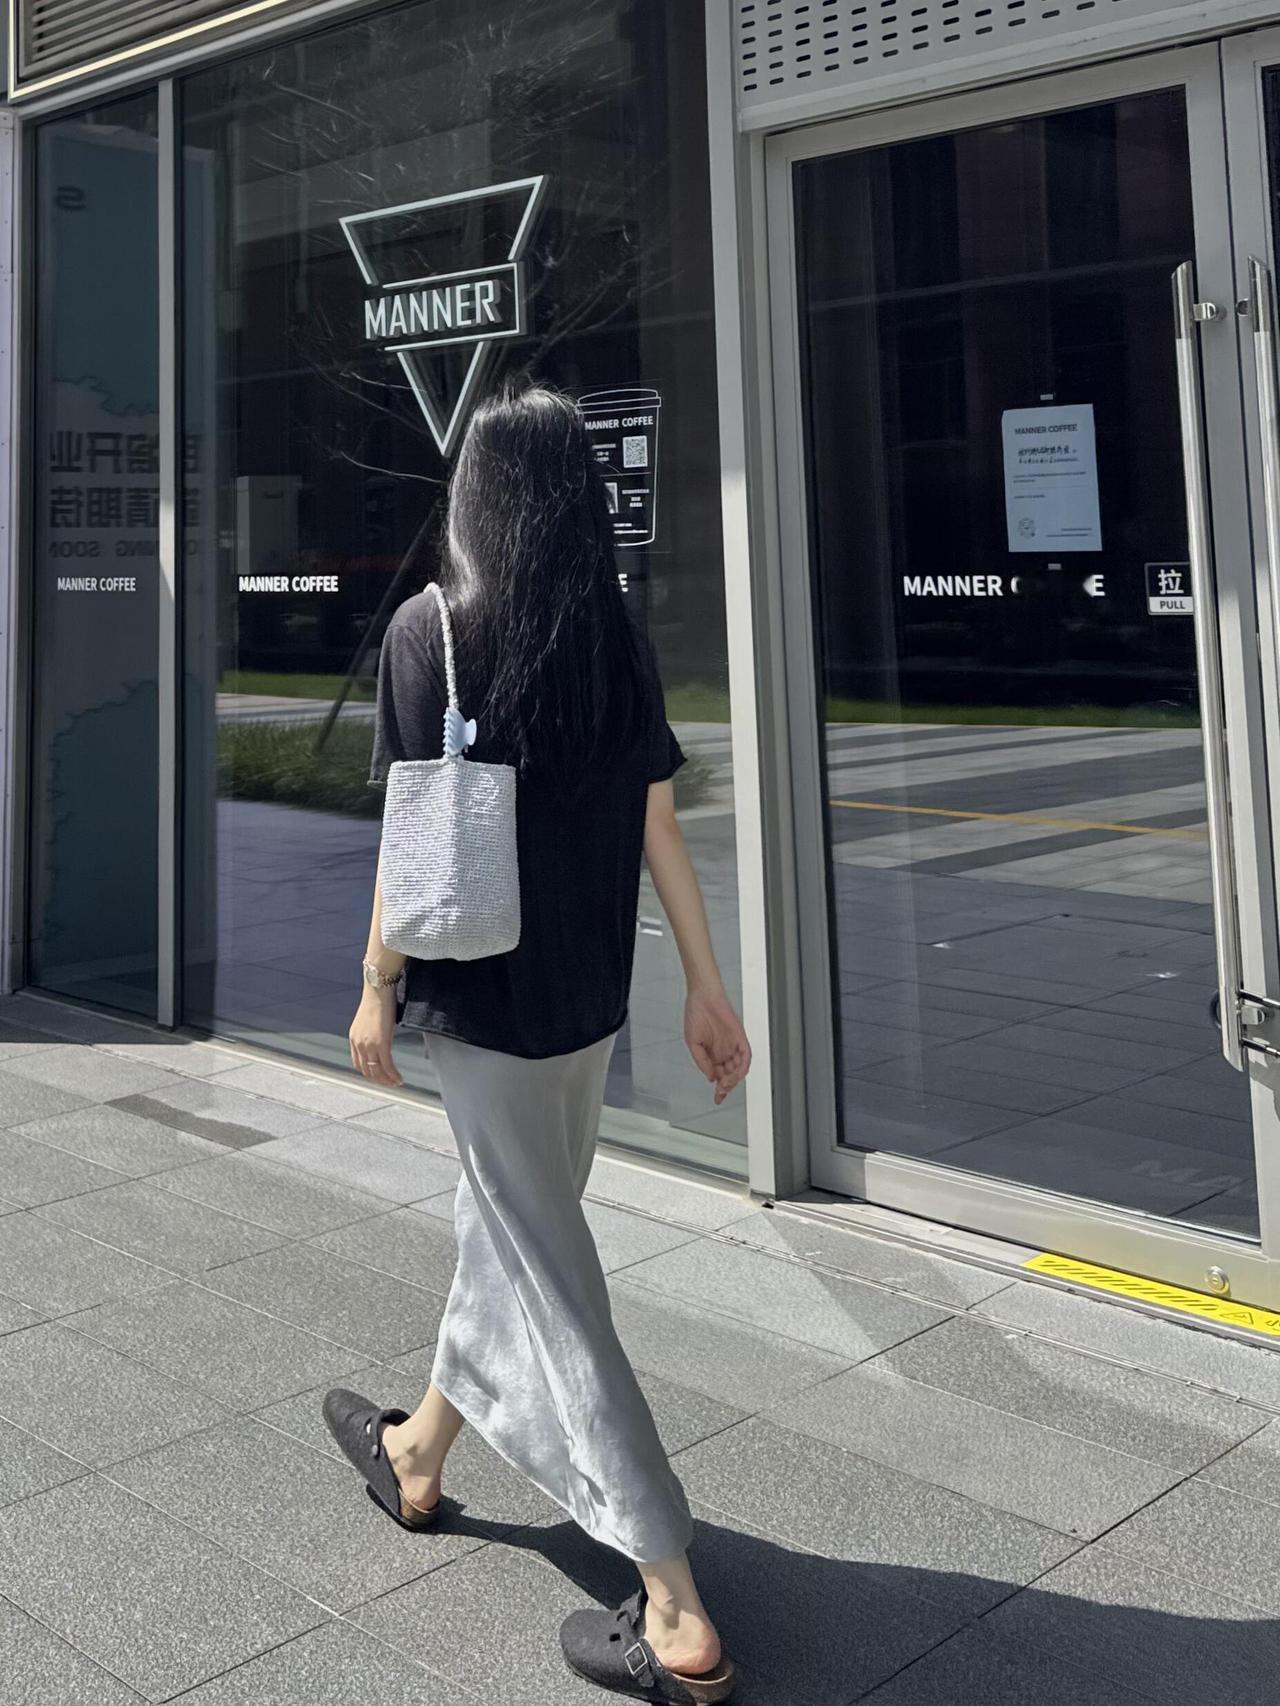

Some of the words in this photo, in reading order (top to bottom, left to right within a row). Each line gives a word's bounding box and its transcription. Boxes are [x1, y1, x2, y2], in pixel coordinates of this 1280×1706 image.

[365, 279, 498, 340] MANNER
[584, 419, 619, 431] MANNER
[621, 416, 653, 427] COFFEE
[57, 577, 97, 591] MANNER
[100, 577, 136, 591] COFFEE
[238, 576, 289, 592] MANNER
[291, 576, 339, 592] COFFEE
[903, 574, 1004, 596] MANNER
[1158, 569, 1184, 595] 拉
[1159, 600, 1186, 610] PULL
